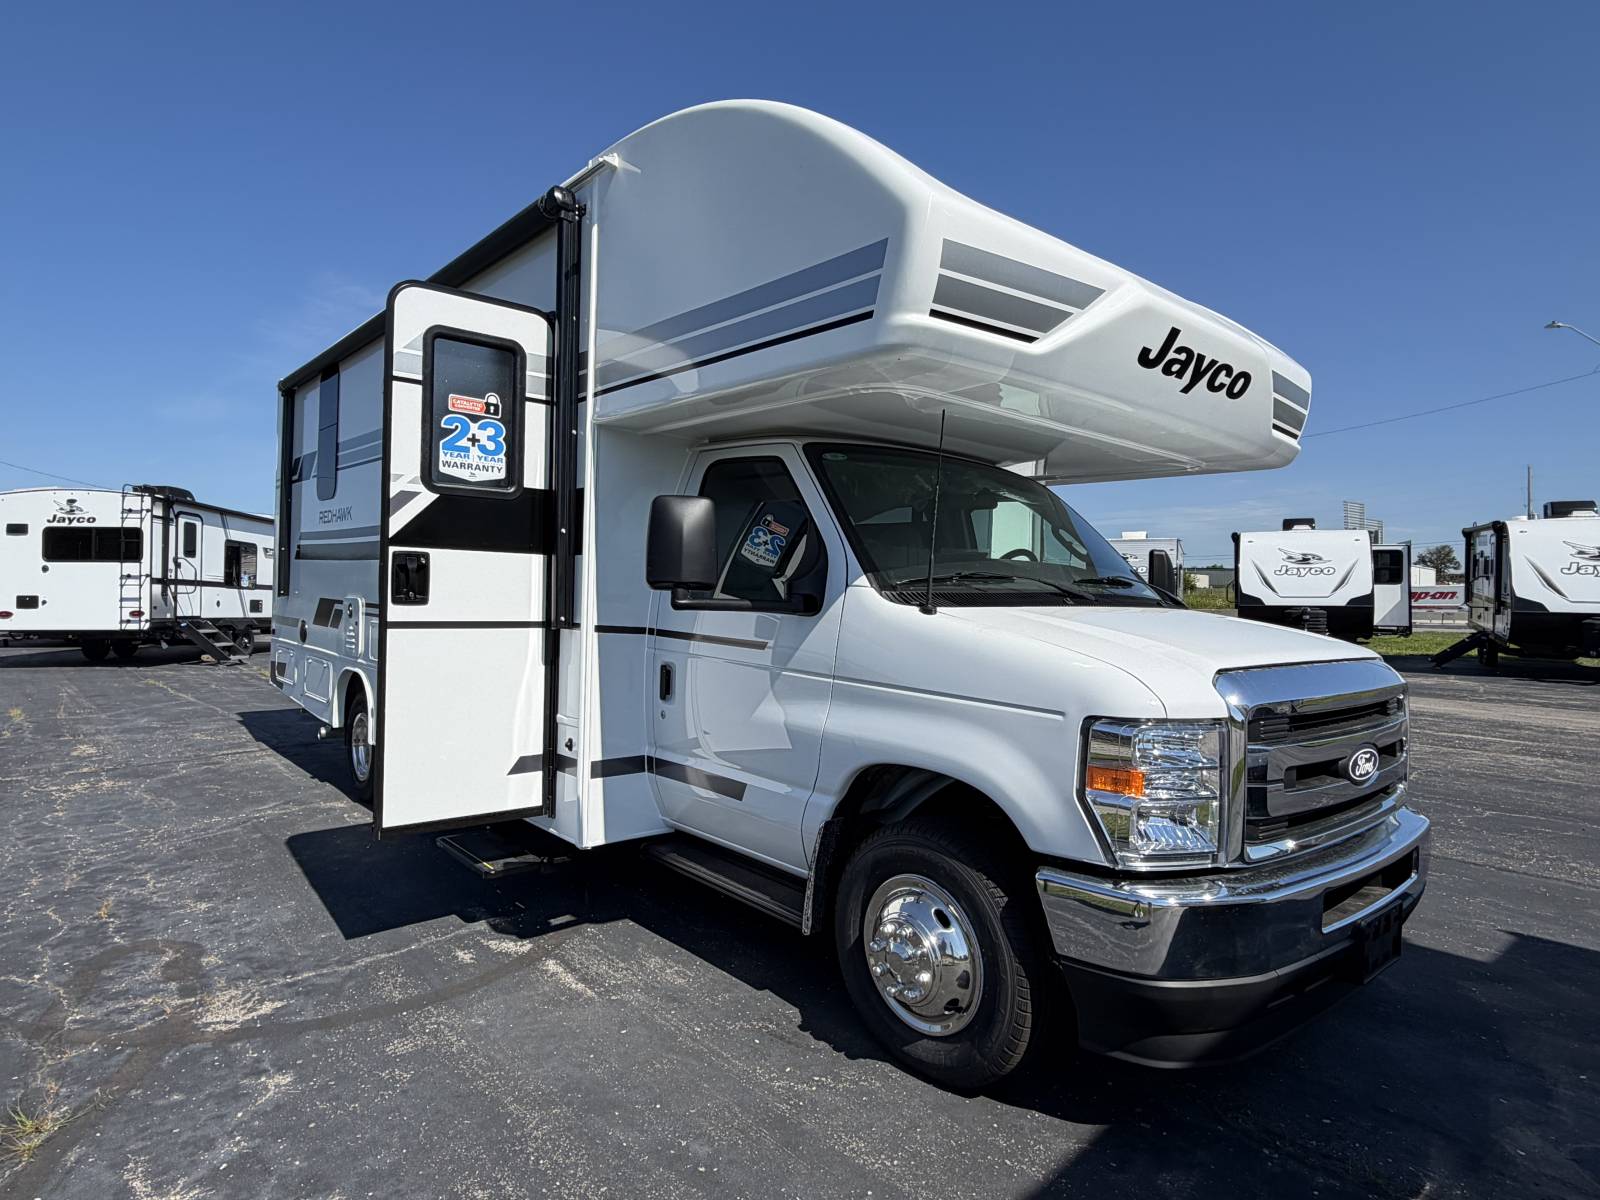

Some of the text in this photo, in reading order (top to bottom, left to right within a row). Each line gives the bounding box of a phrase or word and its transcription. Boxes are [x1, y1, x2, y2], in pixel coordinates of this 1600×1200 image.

[1137, 326, 1252, 400] Jayco
[442, 451, 503, 463] YEAR YEAR
[441, 460, 503, 474] WARRANTY
[46, 514, 97, 525] Jayco
[319, 505, 352, 524] REDHAWK
[1274, 565, 1336, 577] Jayco
